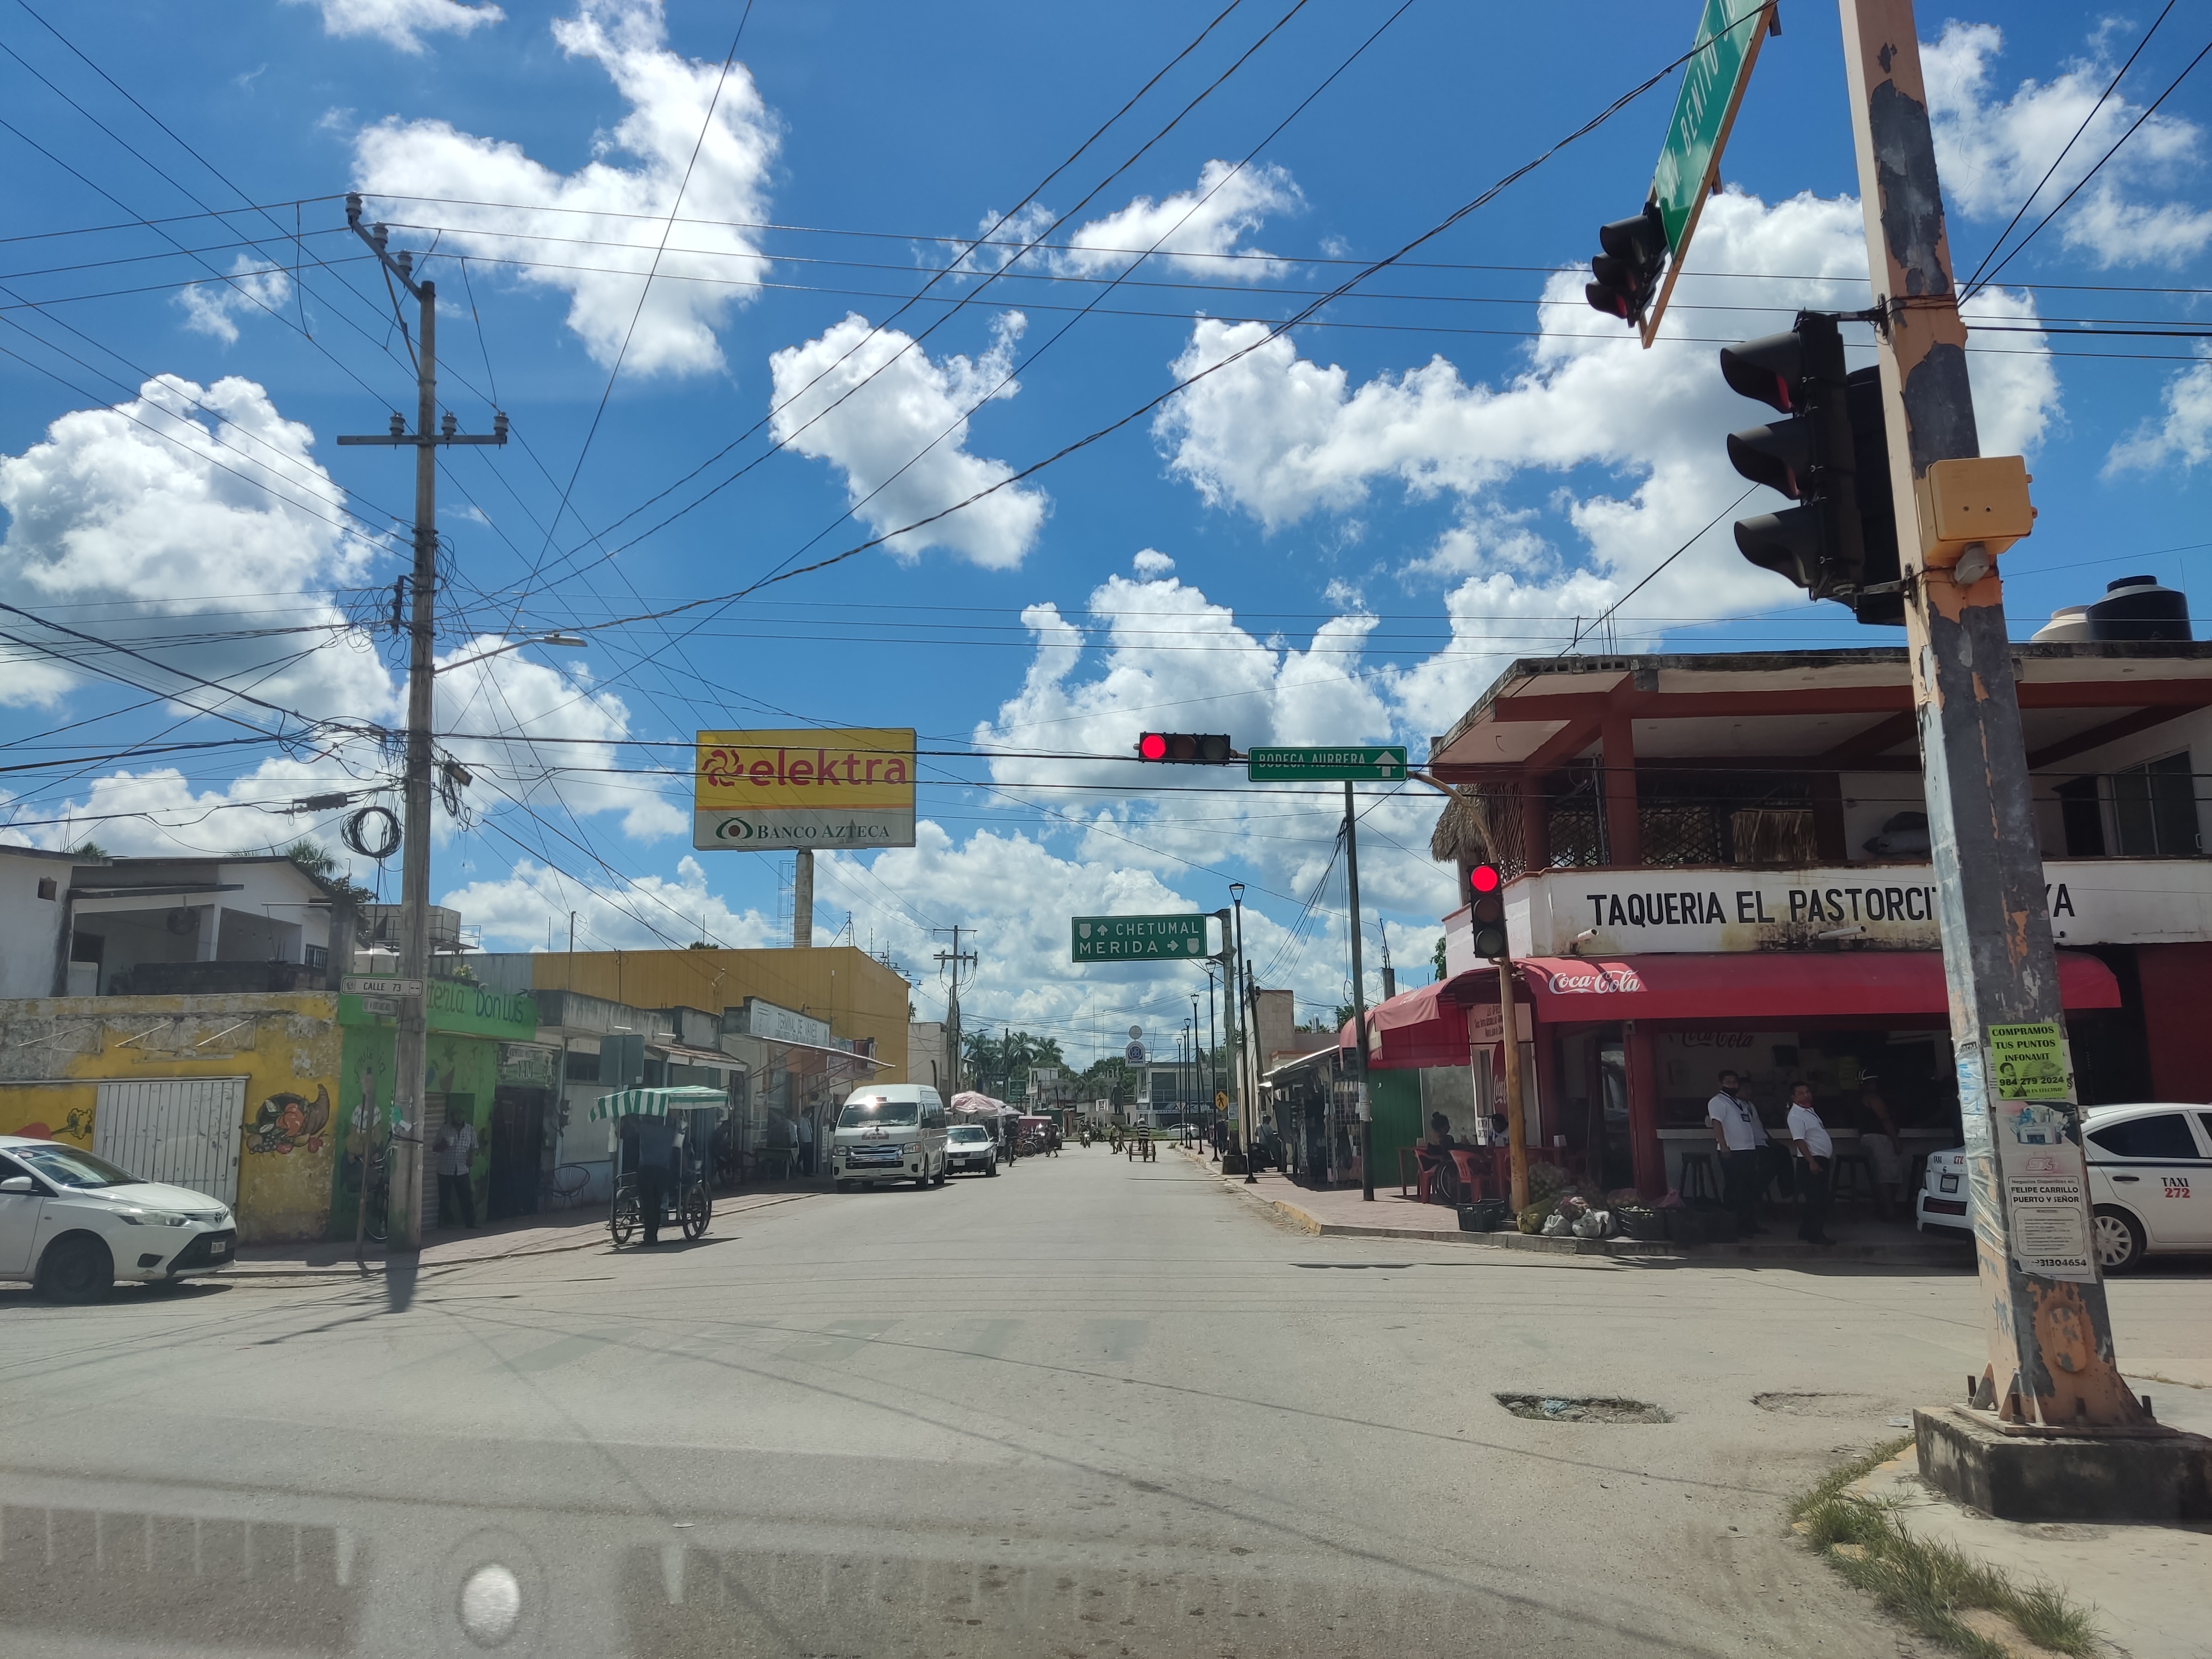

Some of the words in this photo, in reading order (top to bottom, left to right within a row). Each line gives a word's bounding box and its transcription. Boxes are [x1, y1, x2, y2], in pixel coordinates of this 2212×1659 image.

[1681, 32, 1719, 157] BENITO
[1259, 753, 1305, 768] BODEGA
[1311, 753, 1366, 768] AURRERA
[749, 749, 907, 786] elektra
[757, 825, 817, 839] BANCO
[821, 824, 890, 838] AZTECA
[1587, 891, 1726, 928] TAQUERIA
[1736, 890, 1775, 924] EL
[1116, 921, 1199, 936] CHETUMAL
[1079, 941, 1159, 954] MERIDA
[363, 982, 385, 991] CALLE
[1549, 969, 1641, 995] Coca-Cola
[1992, 1026, 2054, 1036] COMPRAMOS
[1994, 1041, 2014, 1050] TUS
[2017, 1040, 2056, 1048] PUNTOS
[2005, 1053, 2051, 1062] INFONAVIT
[1954, 1155, 1964, 1165] 272
[2161, 1177, 2189, 1187] TAXI
[2165, 1187, 2191, 1198] 272
